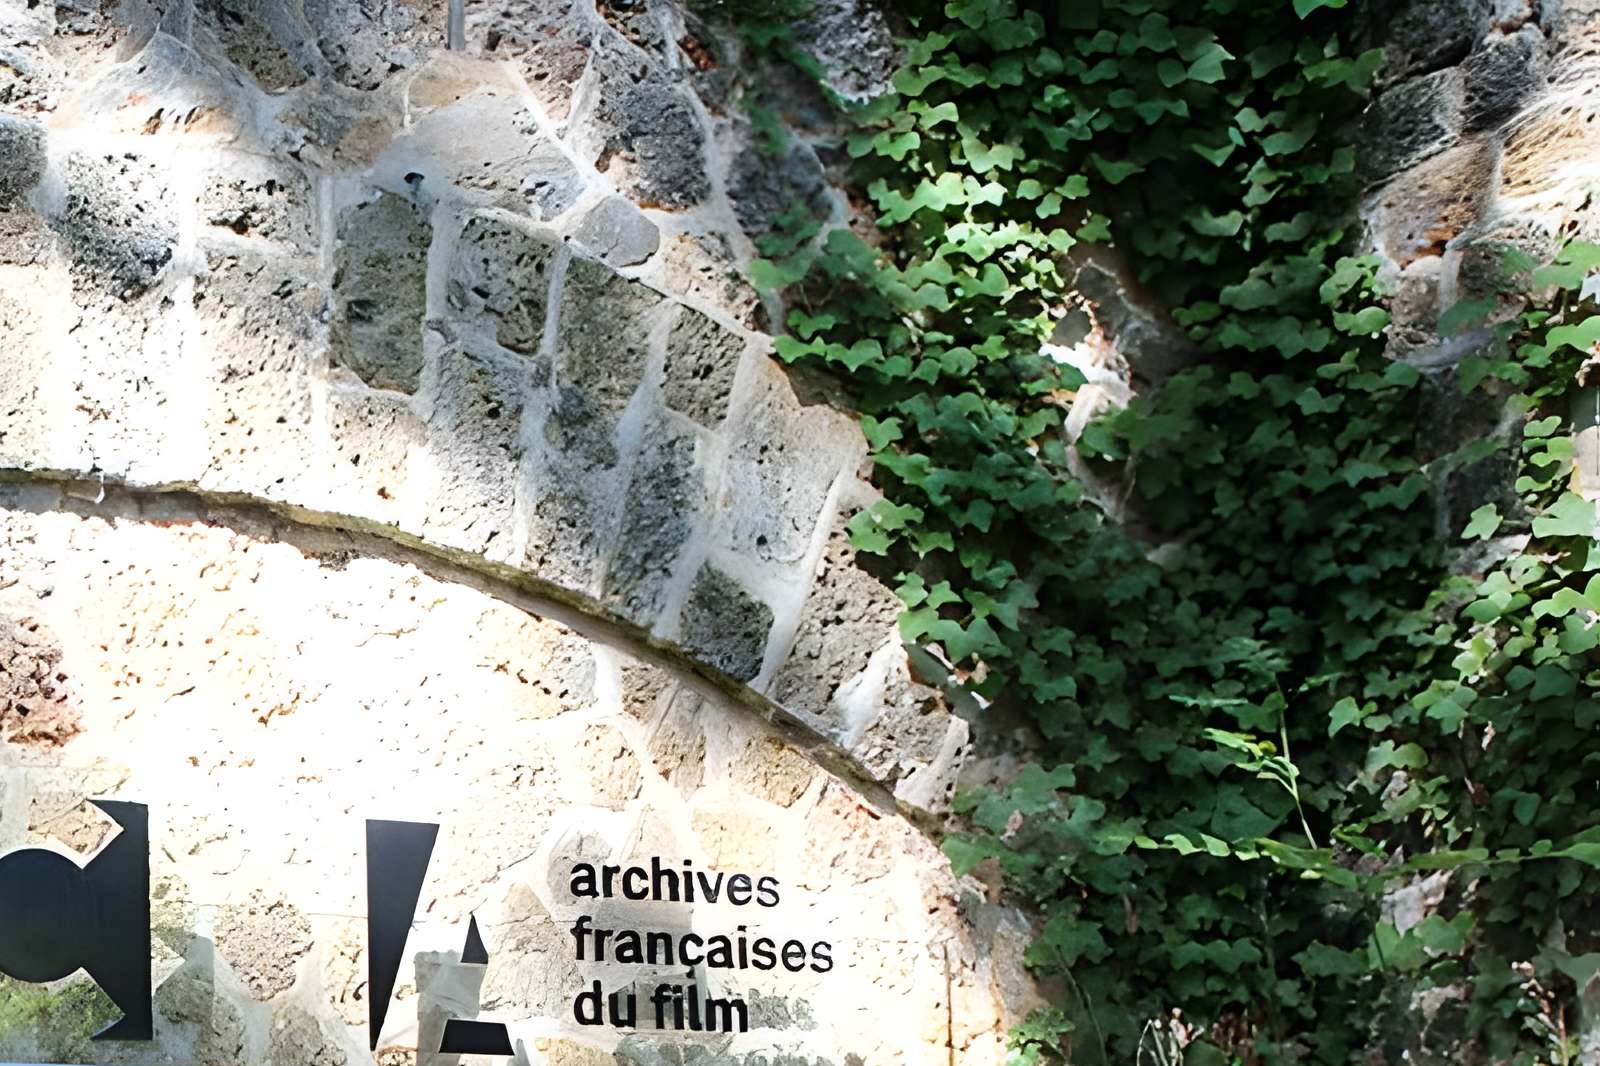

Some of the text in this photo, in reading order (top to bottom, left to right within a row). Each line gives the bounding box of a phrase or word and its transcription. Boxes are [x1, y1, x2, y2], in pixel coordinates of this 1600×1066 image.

[570, 856, 780, 908] archives
[573, 980, 749, 1033] du film
